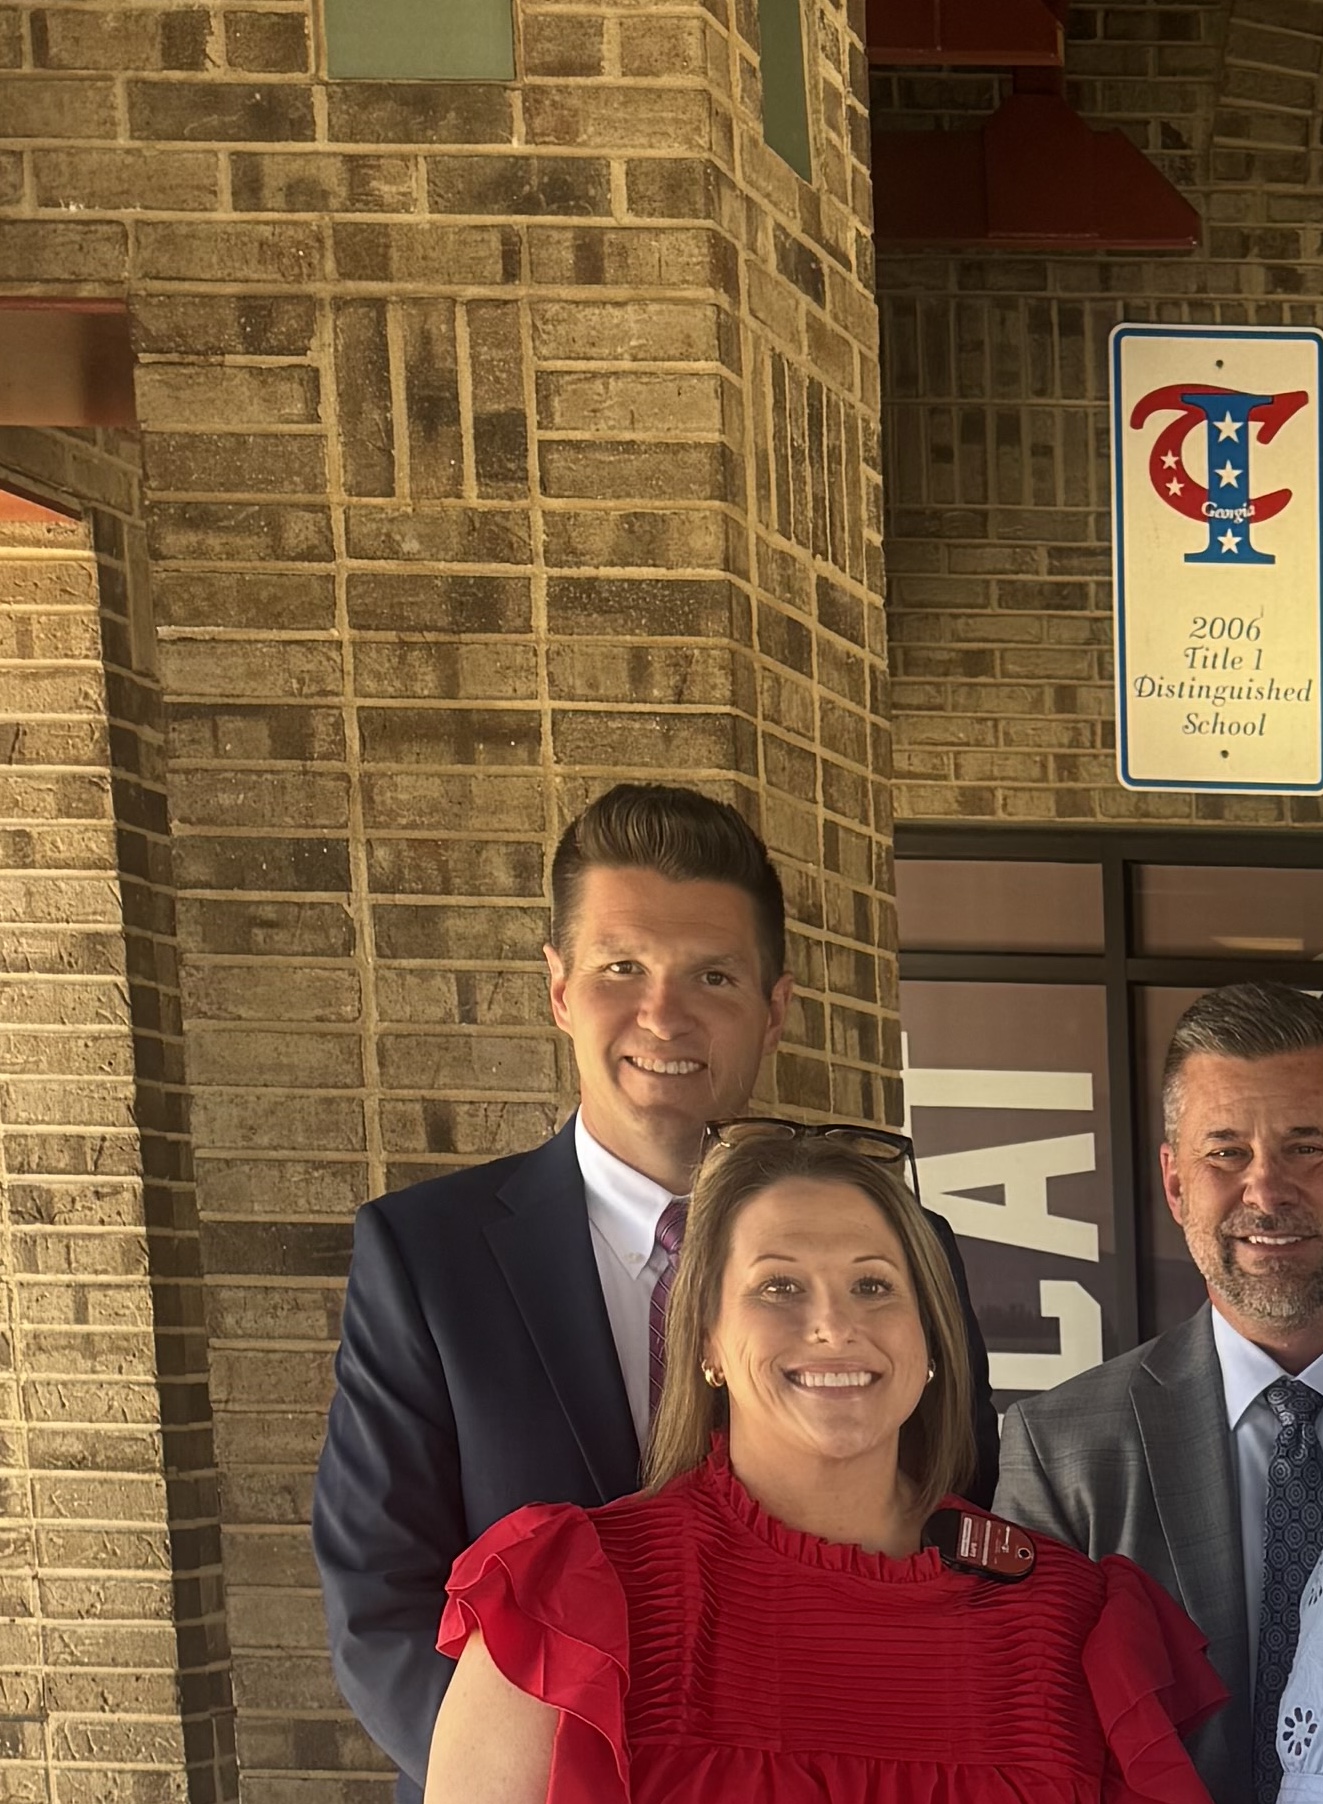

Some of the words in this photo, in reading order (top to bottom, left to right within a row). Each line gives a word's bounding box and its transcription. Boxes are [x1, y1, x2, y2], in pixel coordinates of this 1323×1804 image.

[1201, 502, 1255, 523] Georgia
[1190, 617, 1260, 640] 2006
[1184, 646, 1242, 669] Title
[1134, 675, 1312, 706] Distinguished
[1182, 712, 1266, 736] School
